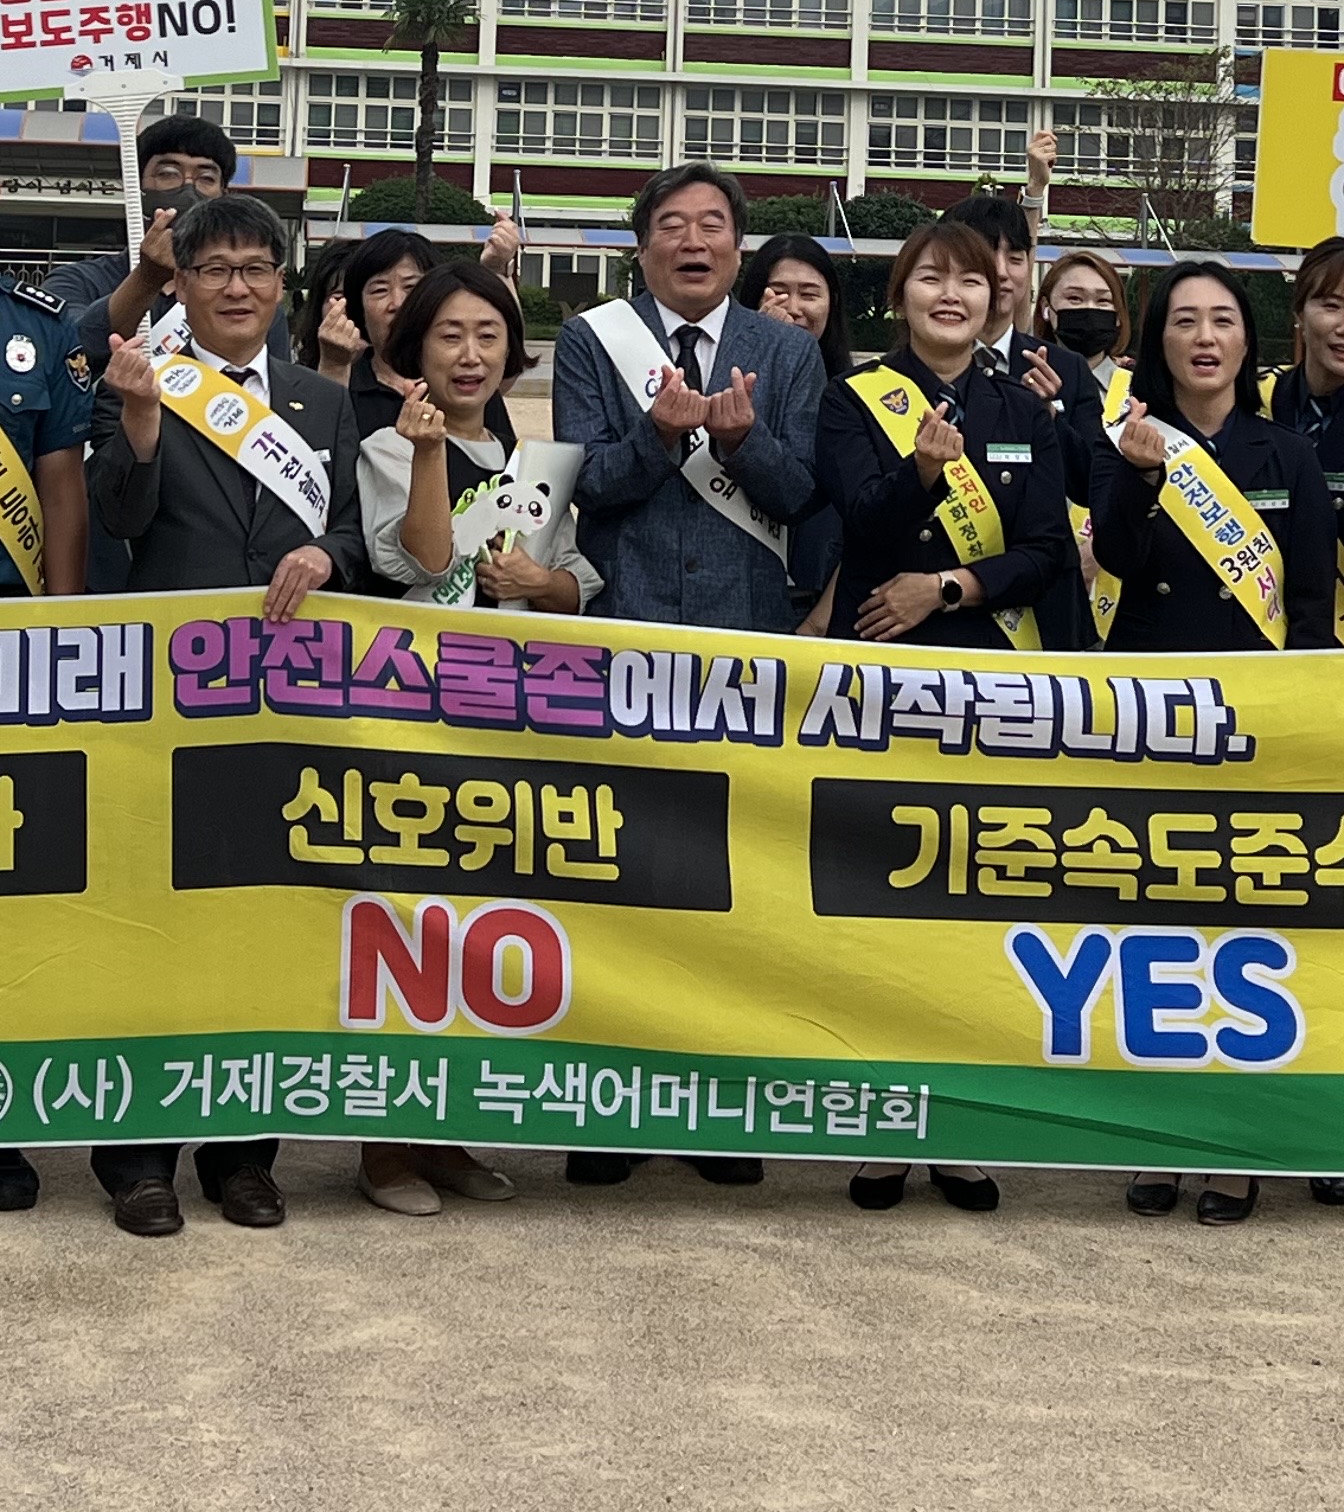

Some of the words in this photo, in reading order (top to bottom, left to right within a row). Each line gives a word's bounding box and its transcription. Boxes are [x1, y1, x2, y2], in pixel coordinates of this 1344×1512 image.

[1168, 462, 1247, 547] 안전보행
[1219, 531, 1274, 583] 3원칙
[169, 616, 788, 747] 안전스쿨존에서
[798, 662, 1257, 765] 시작됩니다.
[281, 765, 625, 882] 신호위반
[339, 892, 572, 1037] NO
[1003, 921, 1306, 1072] YES
[32, 1054, 134, 1125] (사)
[158, 1050, 451, 1122] 거제경찰서
[471, 1058, 930, 1142] 녹색어머니연합회
